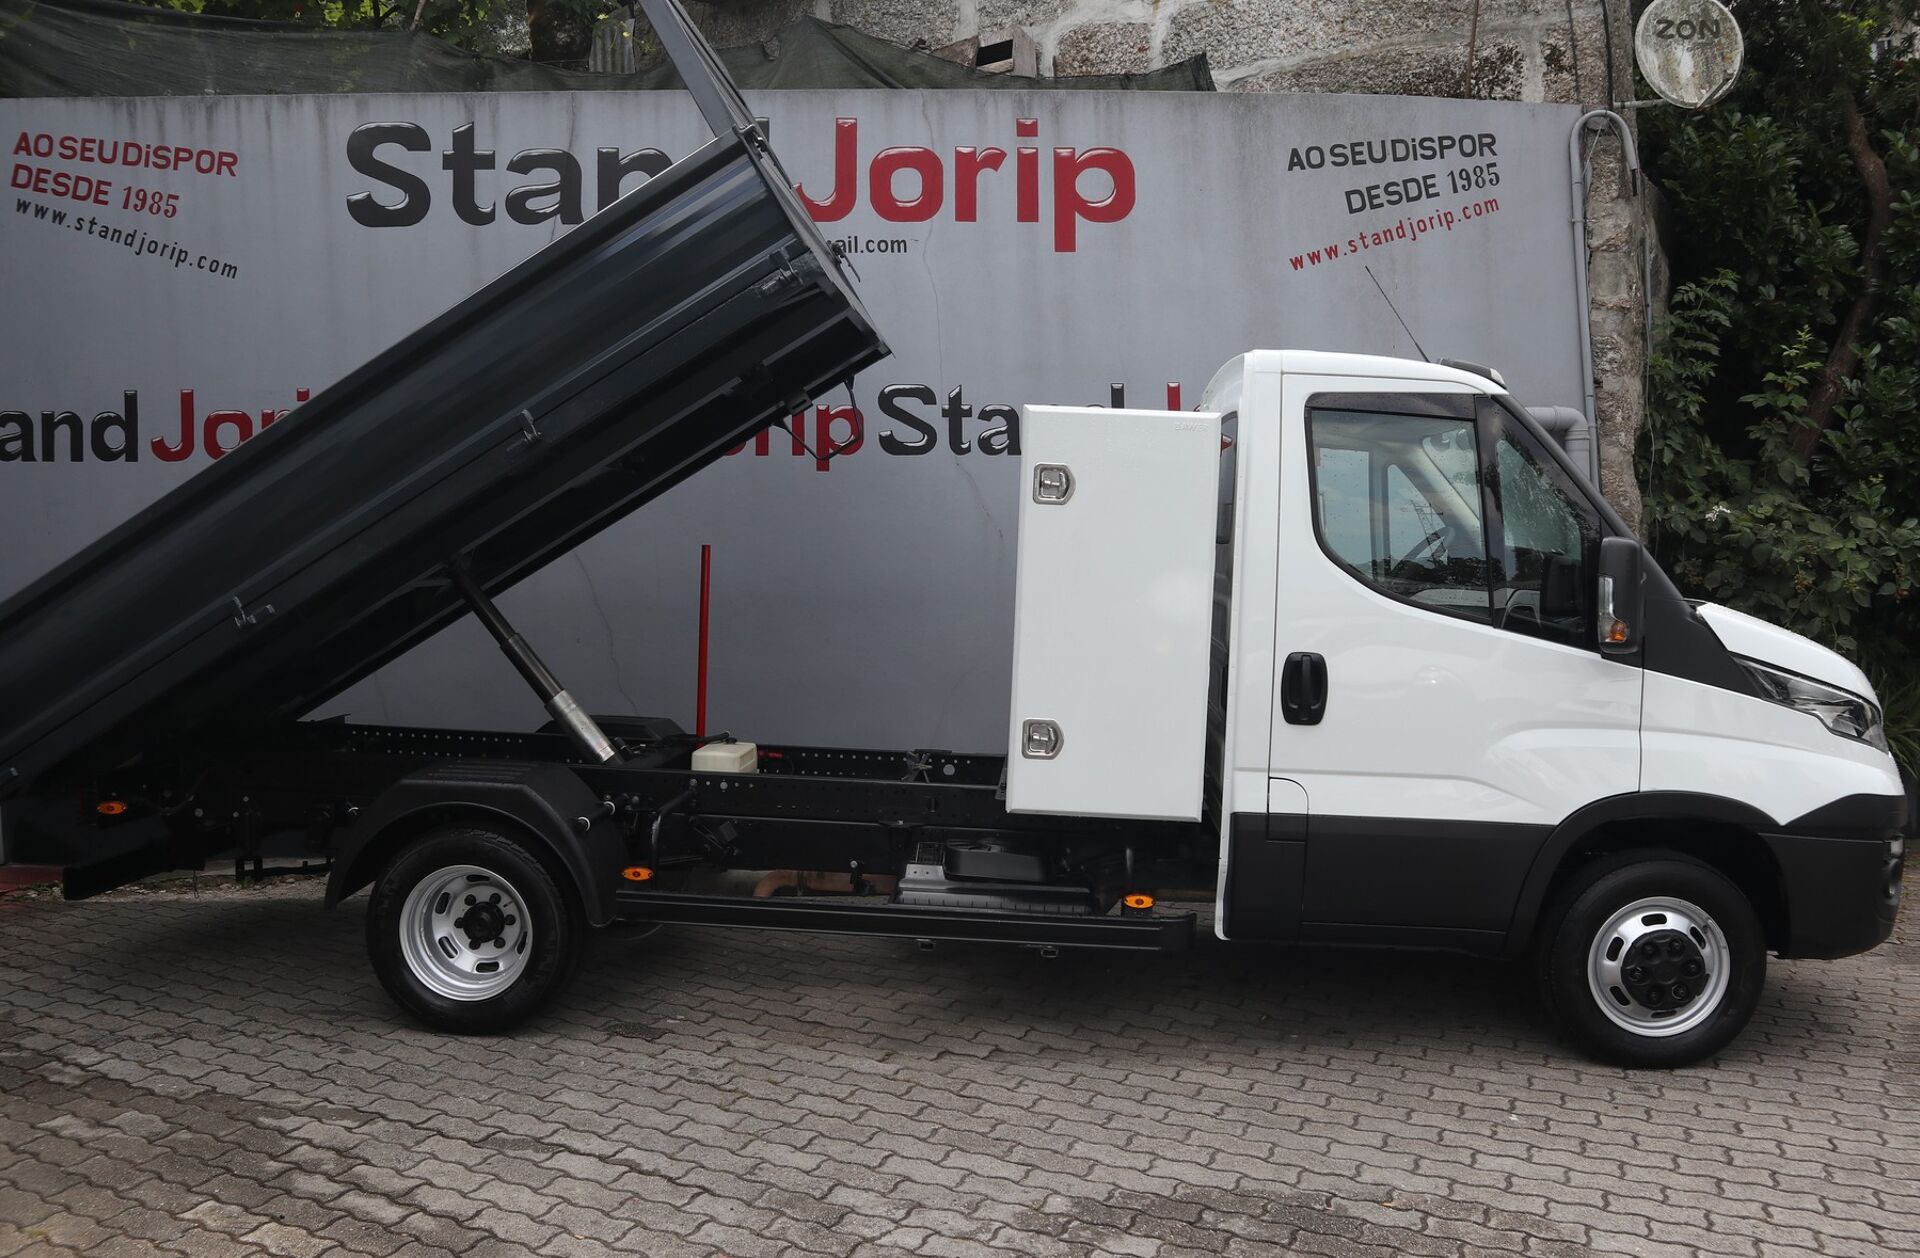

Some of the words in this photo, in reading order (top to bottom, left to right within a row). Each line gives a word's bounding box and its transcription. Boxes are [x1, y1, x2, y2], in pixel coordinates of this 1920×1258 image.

[1655, 19, 1720, 39] ZON
[13, 132, 53, 157] AO
[58, 136, 118, 164] SEU
[1287, 145, 1325, 171] AO
[1329, 140, 1387, 167] SEU
[10, 163, 112, 206] DESDE
[122, 186, 180, 219] 1985
[793, 117, 1136, 252] Jorip
[1345, 174, 1440, 214] DESDE
[1447, 162, 1500, 194] 1985
[15, 198, 239, 280] www.standjorip.com
[1289, 197, 1500, 271] www.standjorip.com
